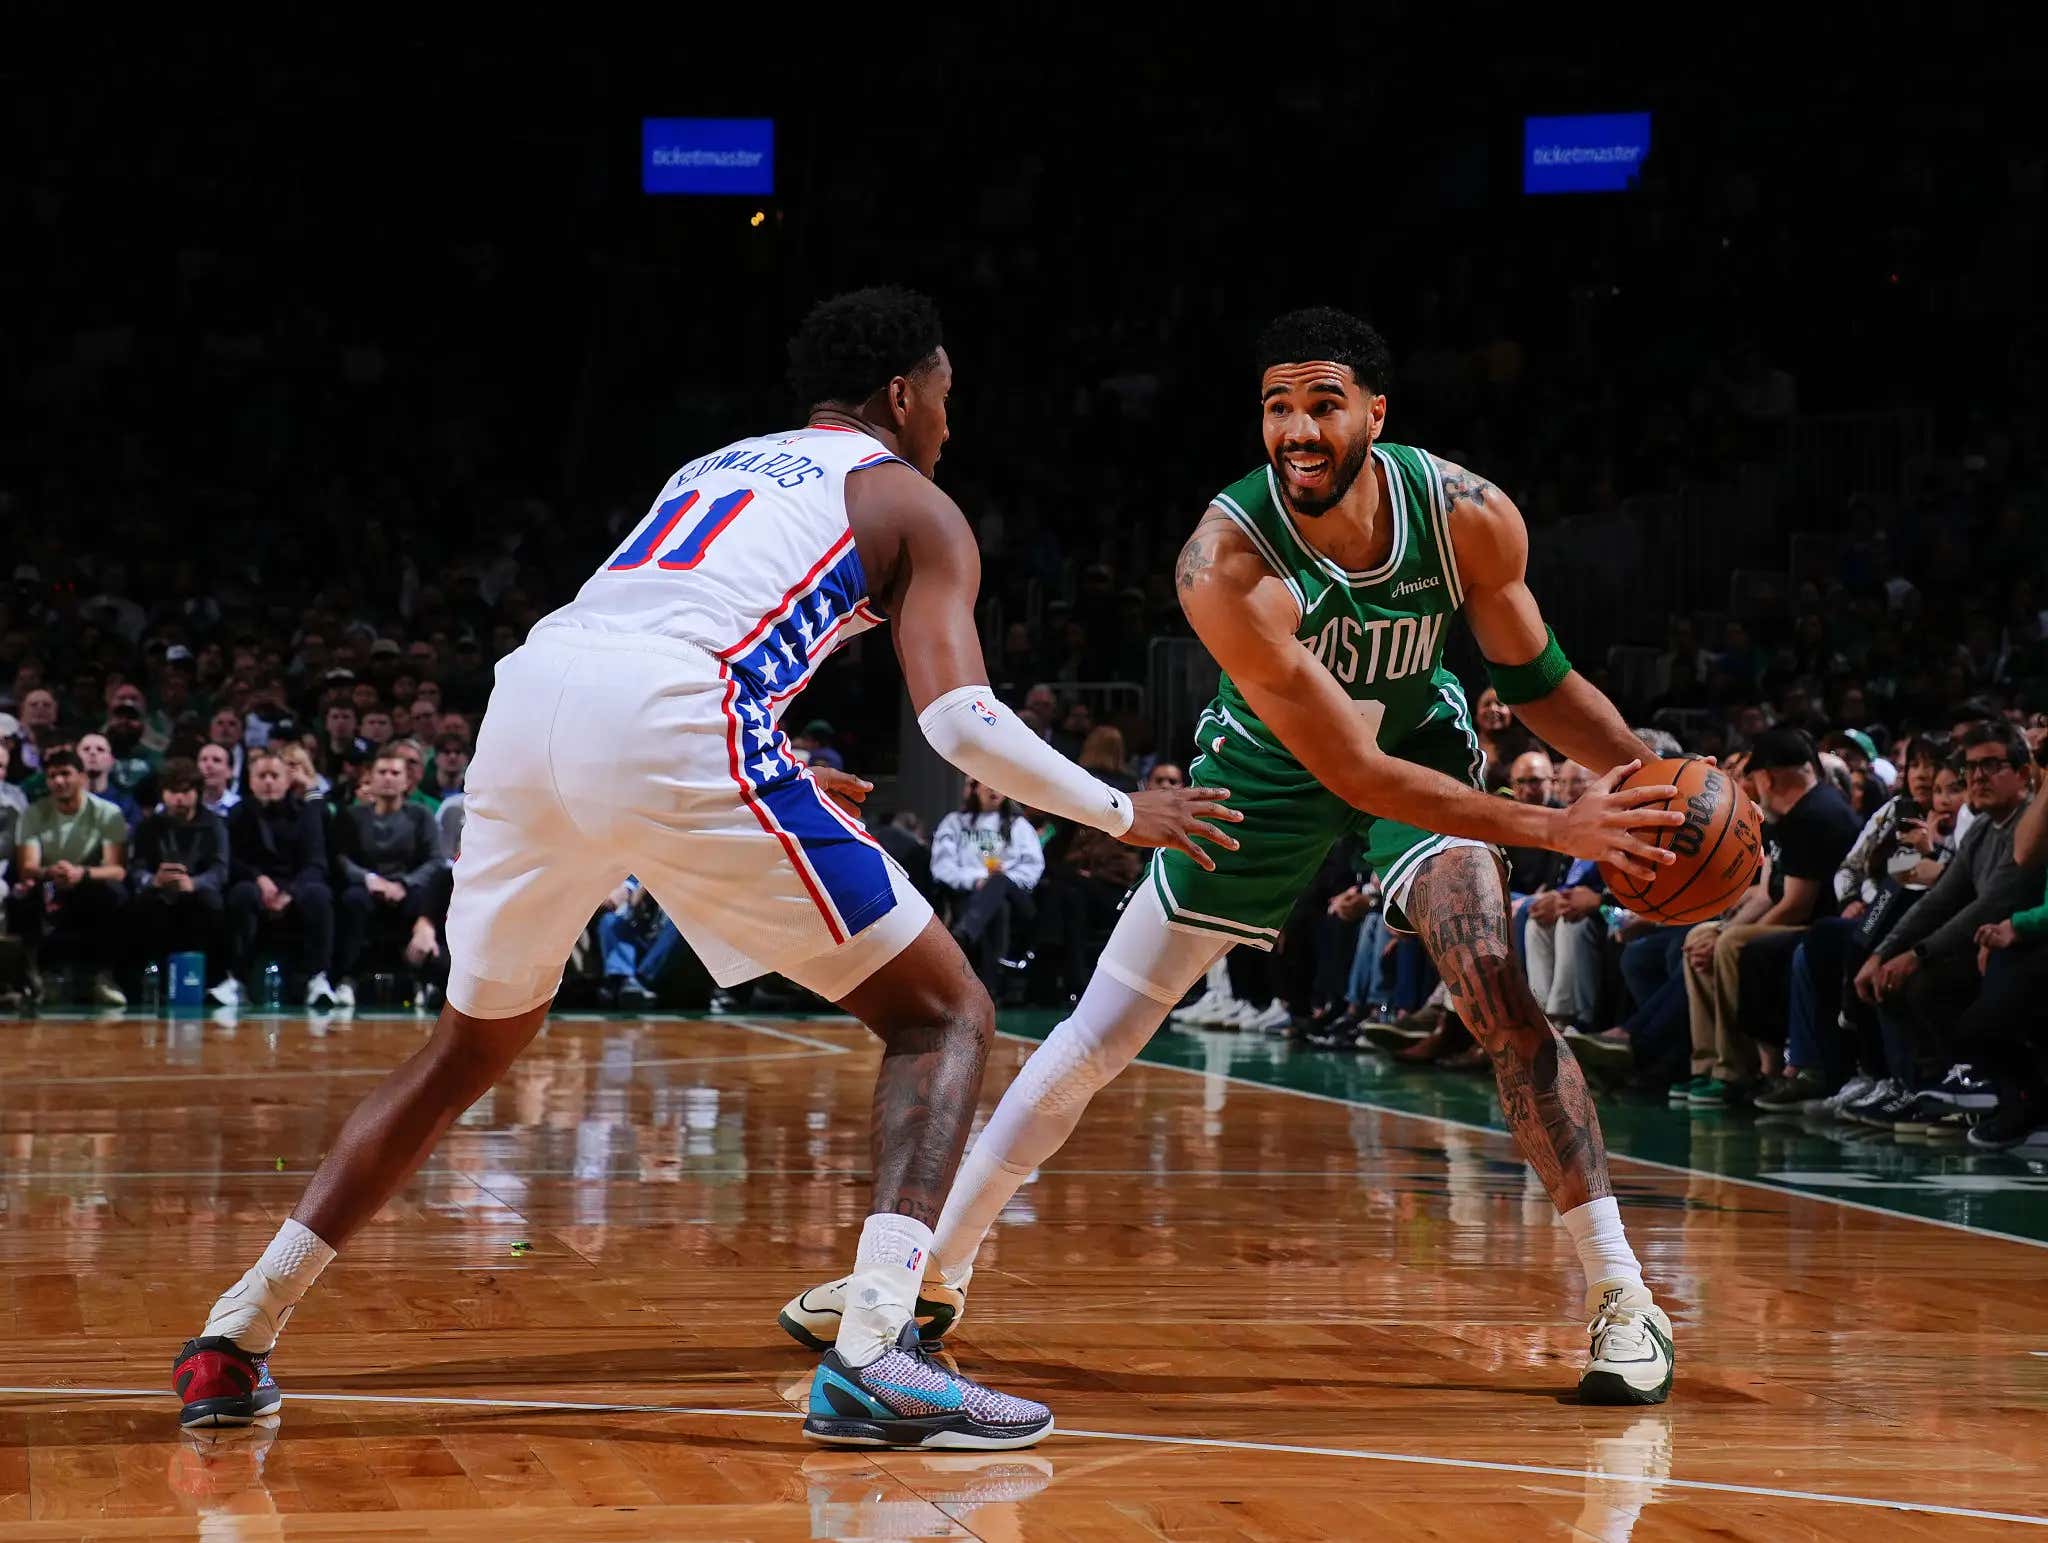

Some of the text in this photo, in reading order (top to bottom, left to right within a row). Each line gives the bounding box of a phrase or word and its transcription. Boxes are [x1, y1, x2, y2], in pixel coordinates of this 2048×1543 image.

[652, 147, 763, 167] ticketmaster
[1533, 145, 1640, 165] ticketmaster
[676, 450, 824, 488] EDWARDS
[607, 489, 755, 571] 11
[1391, 575, 1439, 599] Amica
